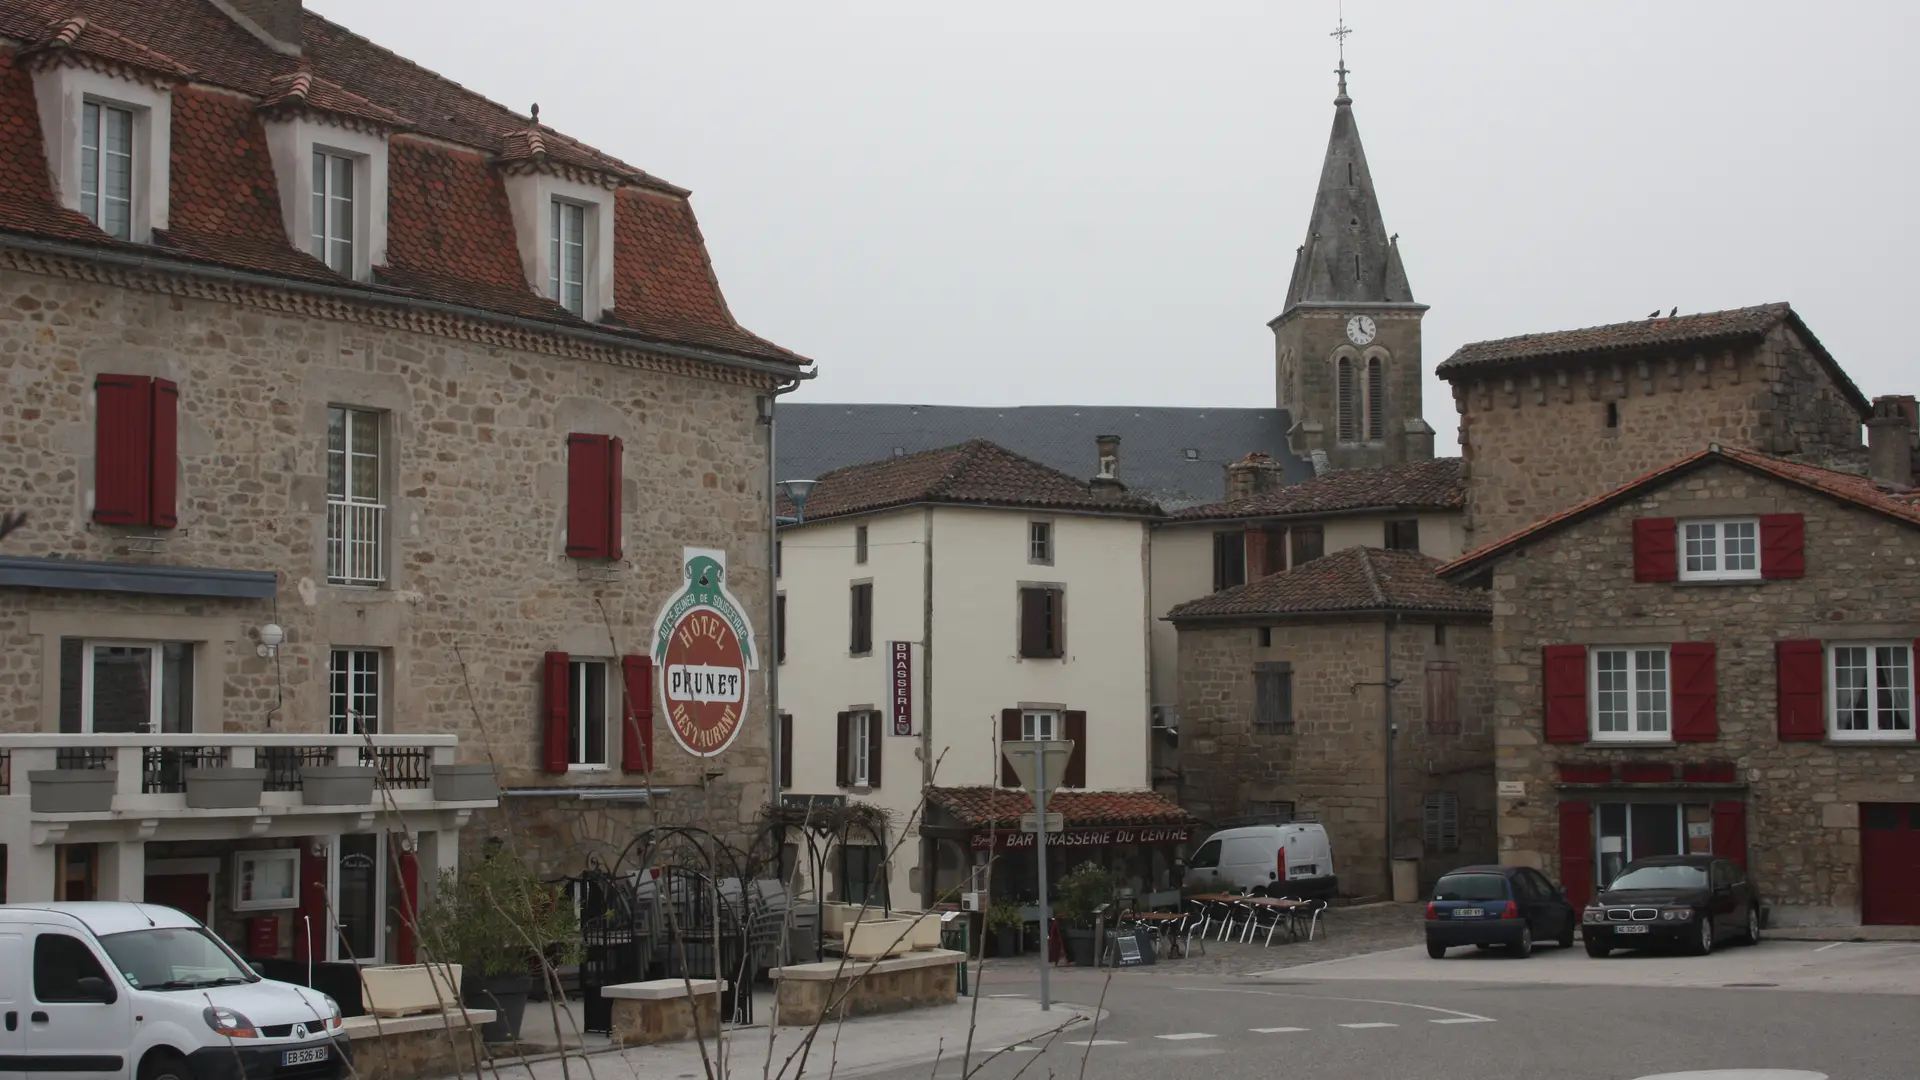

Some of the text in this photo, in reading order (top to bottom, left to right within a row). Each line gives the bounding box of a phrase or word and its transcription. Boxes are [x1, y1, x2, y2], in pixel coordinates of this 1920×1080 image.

[678, 614, 726, 650] HÔTEL
[699, 593, 708, 603] DE
[712, 594, 747, 640] SOUSCEYRAC
[672, 671, 738, 696] PRUNET
[896, 643, 907, 723] BRASSERIE
[672, 702, 737, 748] RESTAURANT
[1006, 833, 1034, 847] BAR
[1116, 830, 1134, 843] DU
[1140, 828, 1188, 842] CENTRE
